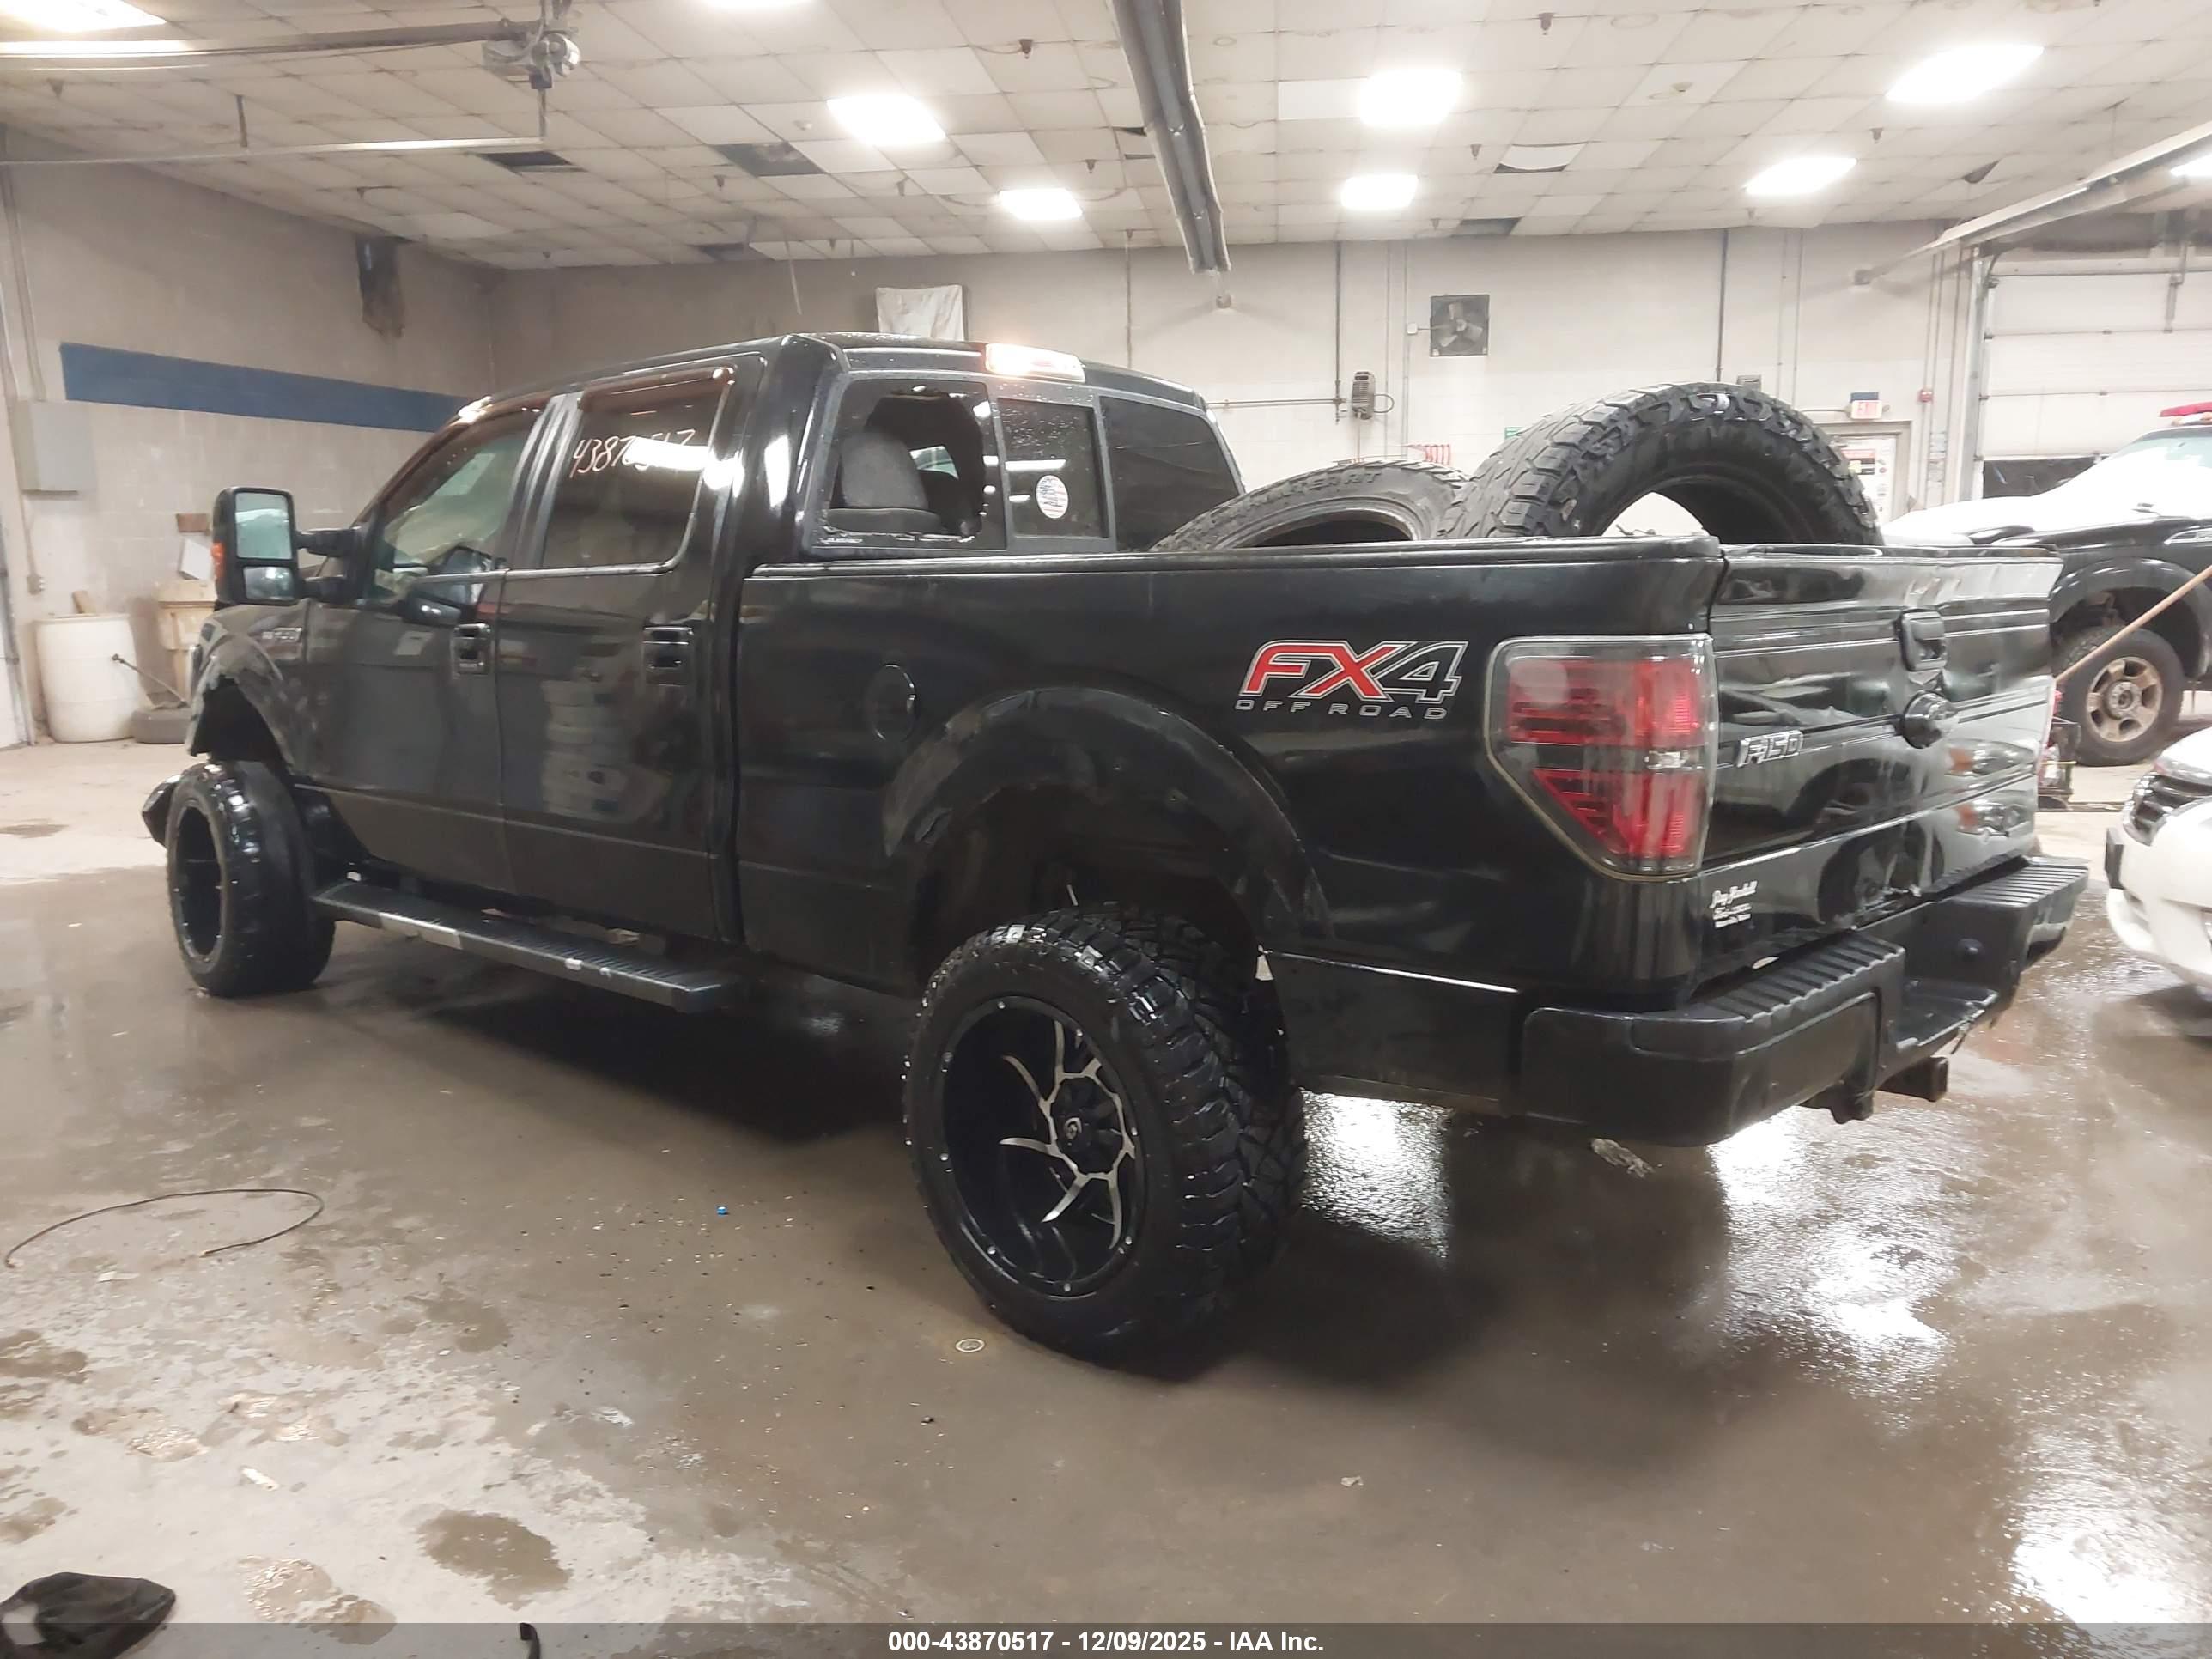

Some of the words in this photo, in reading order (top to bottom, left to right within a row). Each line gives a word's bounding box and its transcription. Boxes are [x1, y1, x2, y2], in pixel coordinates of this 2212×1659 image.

[1238, 639, 1469, 704] FX4
[1235, 698, 1312, 713] OFF
[1328, 702, 1449, 720] ROAD
